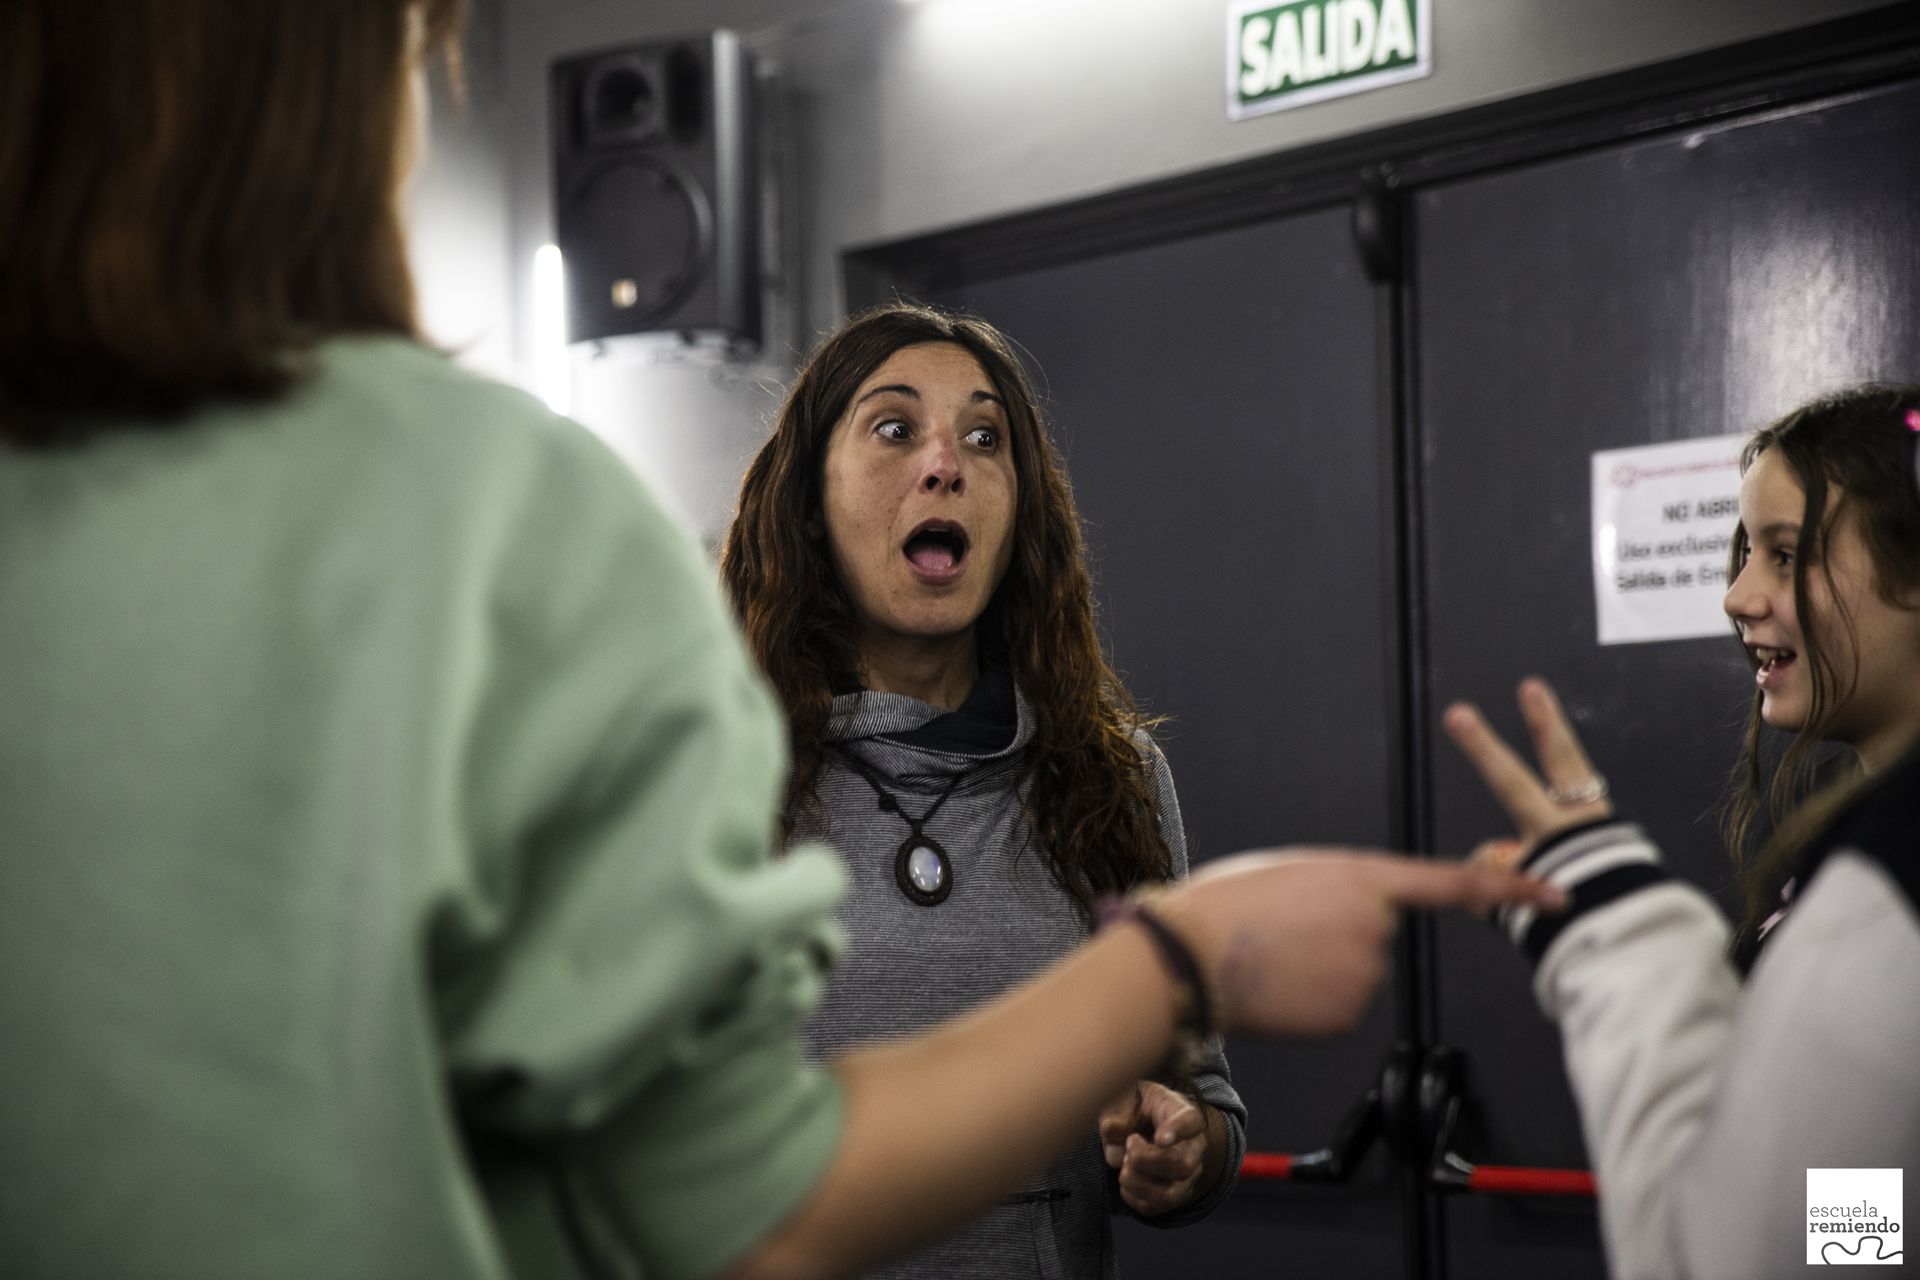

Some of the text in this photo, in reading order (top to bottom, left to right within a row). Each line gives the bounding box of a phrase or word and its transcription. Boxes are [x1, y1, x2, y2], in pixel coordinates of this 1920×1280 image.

[1241, 0, 1415, 96] SALIDA
[1662, 497, 1739, 523] NO ABRI
[1656, 534, 1729, 557] exclusiv
[1617, 569, 1666, 592] Salida
[1672, 566, 1692, 586] de
